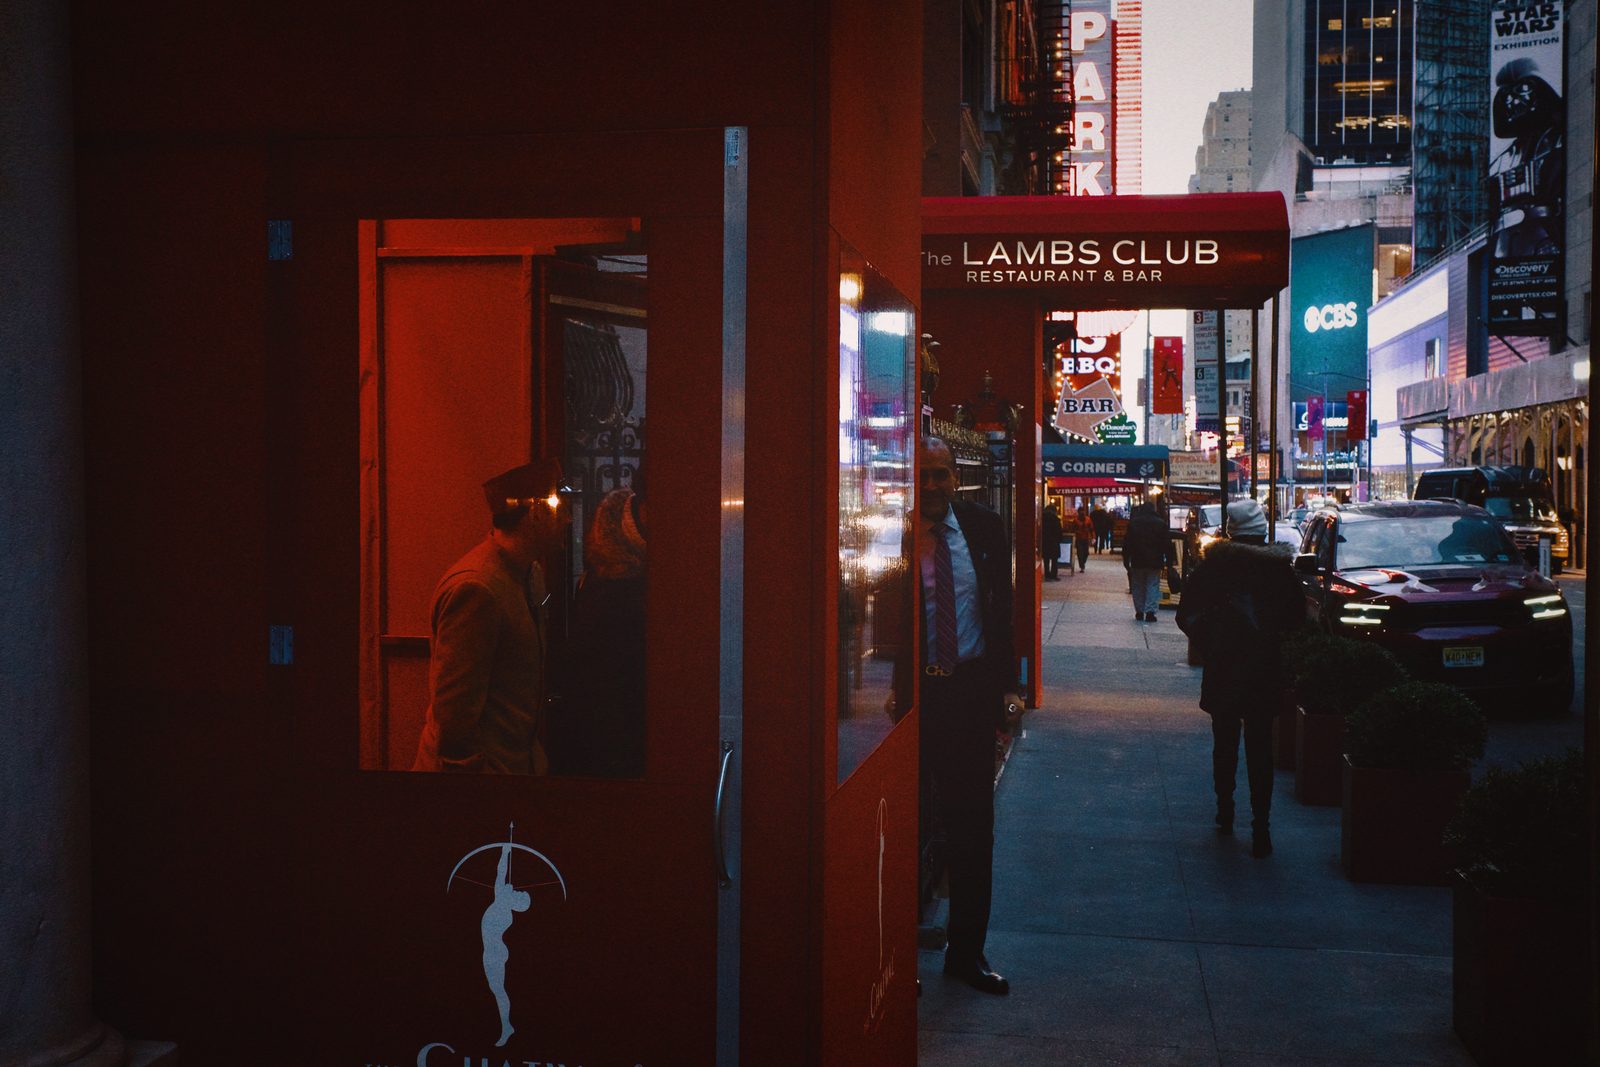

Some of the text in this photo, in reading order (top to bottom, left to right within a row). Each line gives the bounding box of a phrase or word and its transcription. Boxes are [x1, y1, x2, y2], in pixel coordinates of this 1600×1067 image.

[1495, 4, 1560, 23] STAR
[1495, 16, 1560, 37] WARS
[1494, 37, 1559, 50] EXHIBITION
[963, 240, 1101, 266] LAMBS
[1112, 239, 1220, 265] CLUB
[1499, 264, 1550, 275] Discovery
[966, 270, 1163, 283] RESTAURANT & BAR
[1195, 312, 1202, 323] 3
[1320, 301, 1358, 331] CBS
[1062, 357, 1116, 375] BBQ
[1197, 368, 1203, 379] 6
[1063, 399, 1114, 414] BAR
[1062, 461, 1127, 474] CORNER
[1055, 487, 1091, 495] VIRGIL'S
